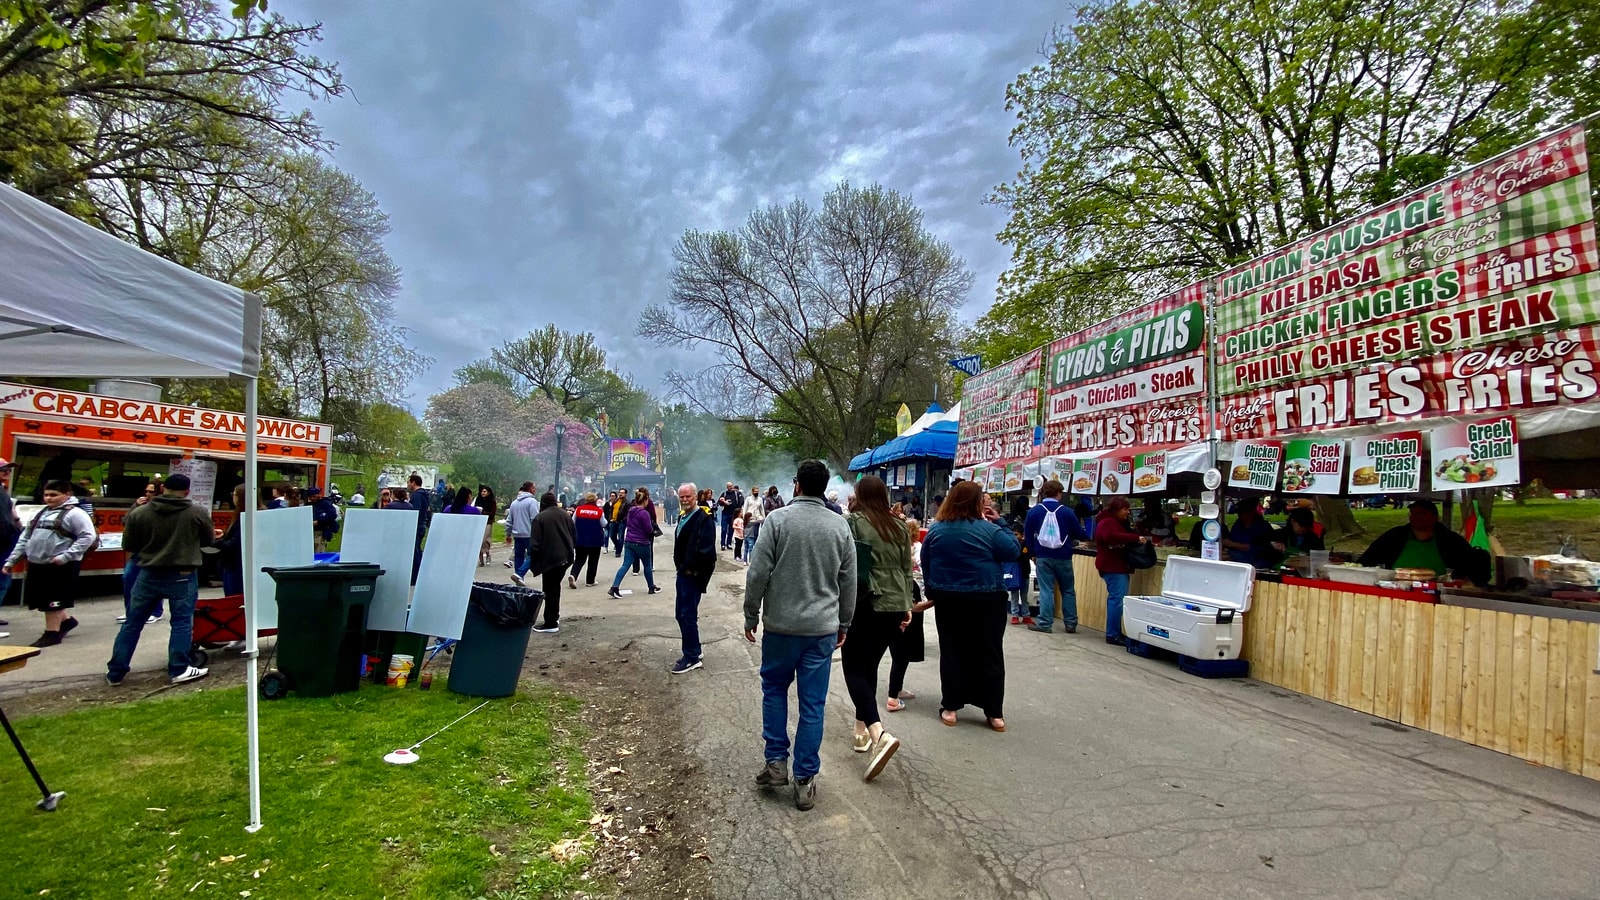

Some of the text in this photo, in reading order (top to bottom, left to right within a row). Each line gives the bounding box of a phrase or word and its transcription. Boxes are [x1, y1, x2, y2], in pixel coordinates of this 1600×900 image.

[1470, 159, 1565, 207] & Onions
[1222, 136, 1571, 300] ITALIAN SAUSAGE with Peppers
[1407, 231, 1496, 270] & Onions
[1260, 210, 1502, 316] KIELBASA with Peppers
[1488, 247, 1576, 291] FRIES
[1225, 252, 1510, 358] CHICKEN FINGERS with
[1056, 339, 1106, 385] GYROS
[1110, 337, 1125, 366] &
[1128, 309, 1192, 364] PITAS
[1234, 290, 1558, 387] PHILLY CHEESE STEAK
[1452, 339, 1580, 379] Cheese
[1053, 365, 1195, 414] Lamb Chicken Steak
[1274, 365, 1425, 430] FRIES
[1444, 358, 1598, 413] FRIES
[33, 391, 196, 428] CRABCAKE
[1146, 405, 1197, 424] Cheese
[980, 417, 1004, 434] CHEESE
[1005, 413, 1029, 429] STEAK
[1071, 413, 1136, 450] FRIES
[1142, 417, 1201, 443] FRIES
[1233, 414, 1264, 432] cut
[1467, 419, 1512, 443] Greek
[613, 453, 645, 463] COTTON
[970, 437, 1003, 462] FRIES
[1004, 440, 1033, 459] FRIES
[1244, 444, 1278, 459] Chicken
[1310, 443, 1340, 459] Greek
[1366, 439, 1417, 457] Chicken
[1470, 438, 1513, 460] Salad
[1117, 461, 1130, 473] Gyro
[1144, 453, 1165, 467] Loaded
[1155, 465, 1165, 476] Fry
[1248, 458, 1277, 473] Breast
[1309, 458, 1339, 473] Salad
[1374, 455, 1416, 473] Breast
[1250, 471, 1274, 488] Philly
[1379, 471, 1416, 490] Philly
